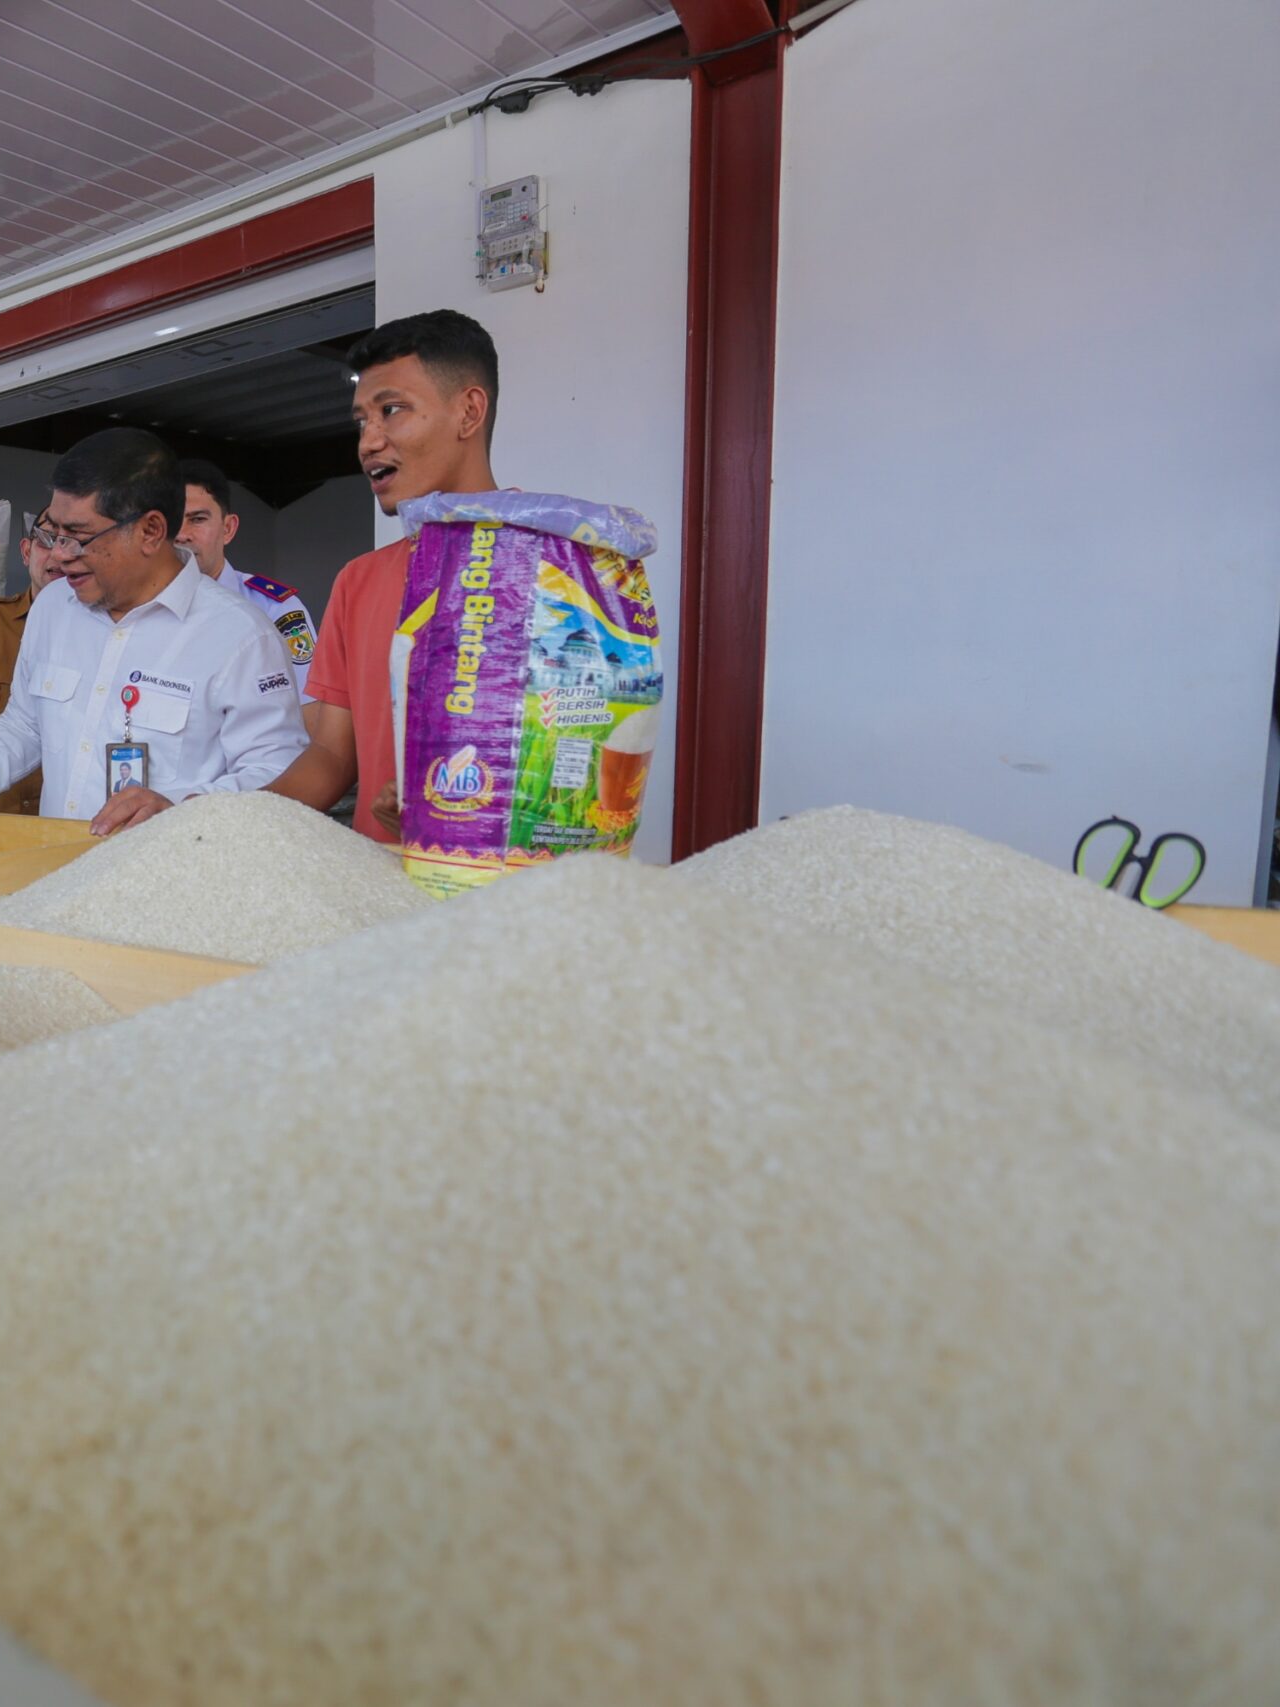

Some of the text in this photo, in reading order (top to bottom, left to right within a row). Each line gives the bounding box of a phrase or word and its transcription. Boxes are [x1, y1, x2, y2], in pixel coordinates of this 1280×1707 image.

[445, 521, 504, 715] lang Bintang
[141, 674, 191, 693] BANK INDONESIA
[556, 687, 596, 698] PUTIH
[557, 700, 606, 711] BERSIH
[557, 713, 612, 724] HIGIENIS
